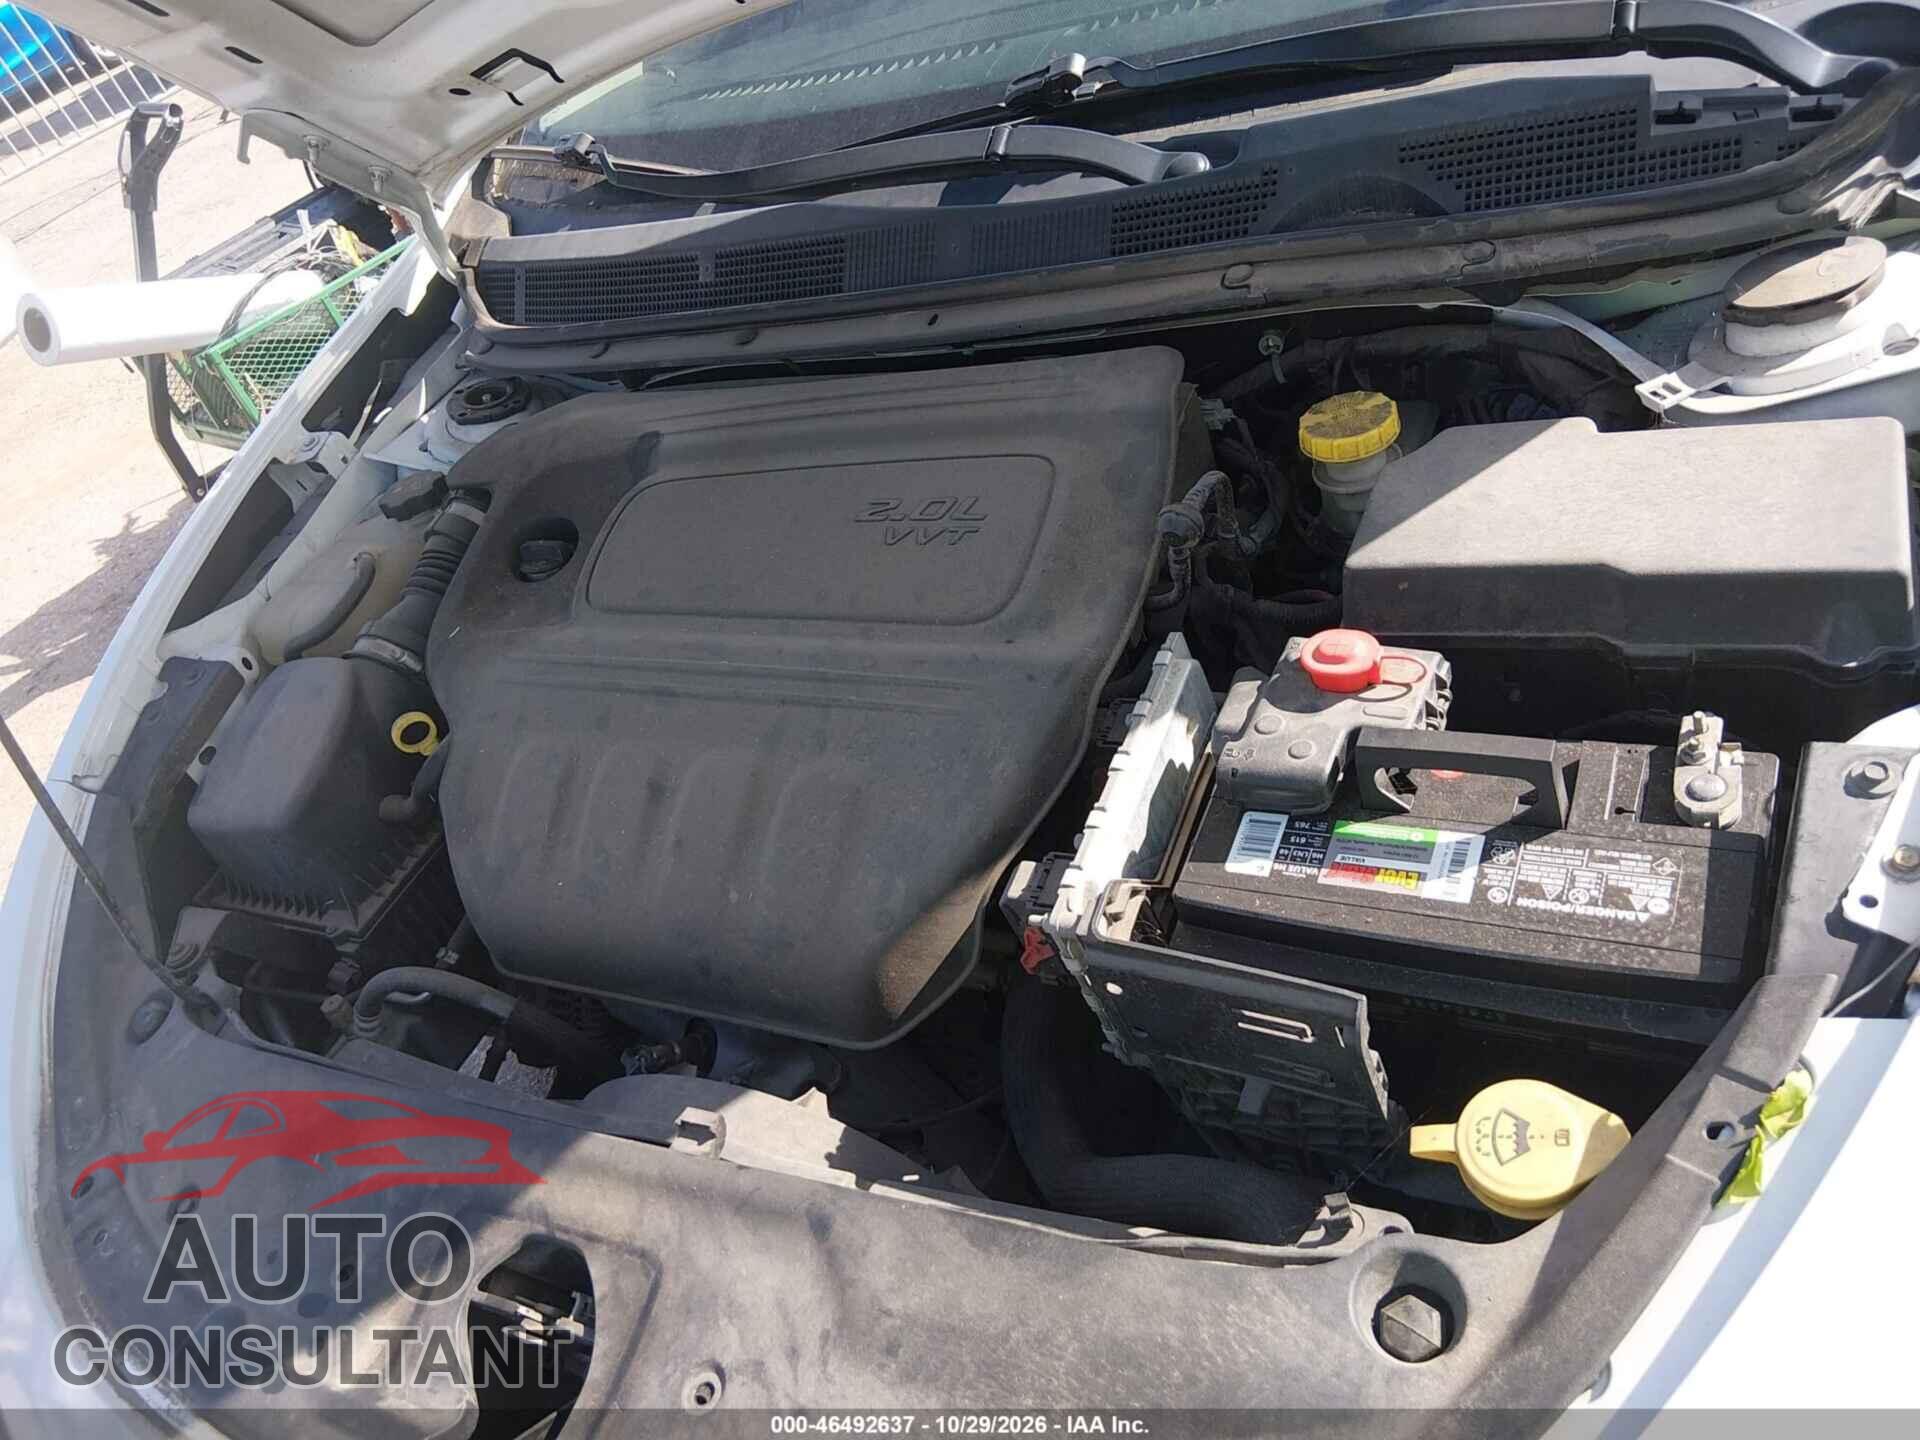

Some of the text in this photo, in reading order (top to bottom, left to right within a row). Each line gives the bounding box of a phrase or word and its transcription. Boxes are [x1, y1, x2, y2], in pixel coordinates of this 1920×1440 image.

[853, 496, 989, 522] 2.0L
[884, 526, 981, 546] VVT
[1516, 897, 1636, 921] DANGER/POISON
